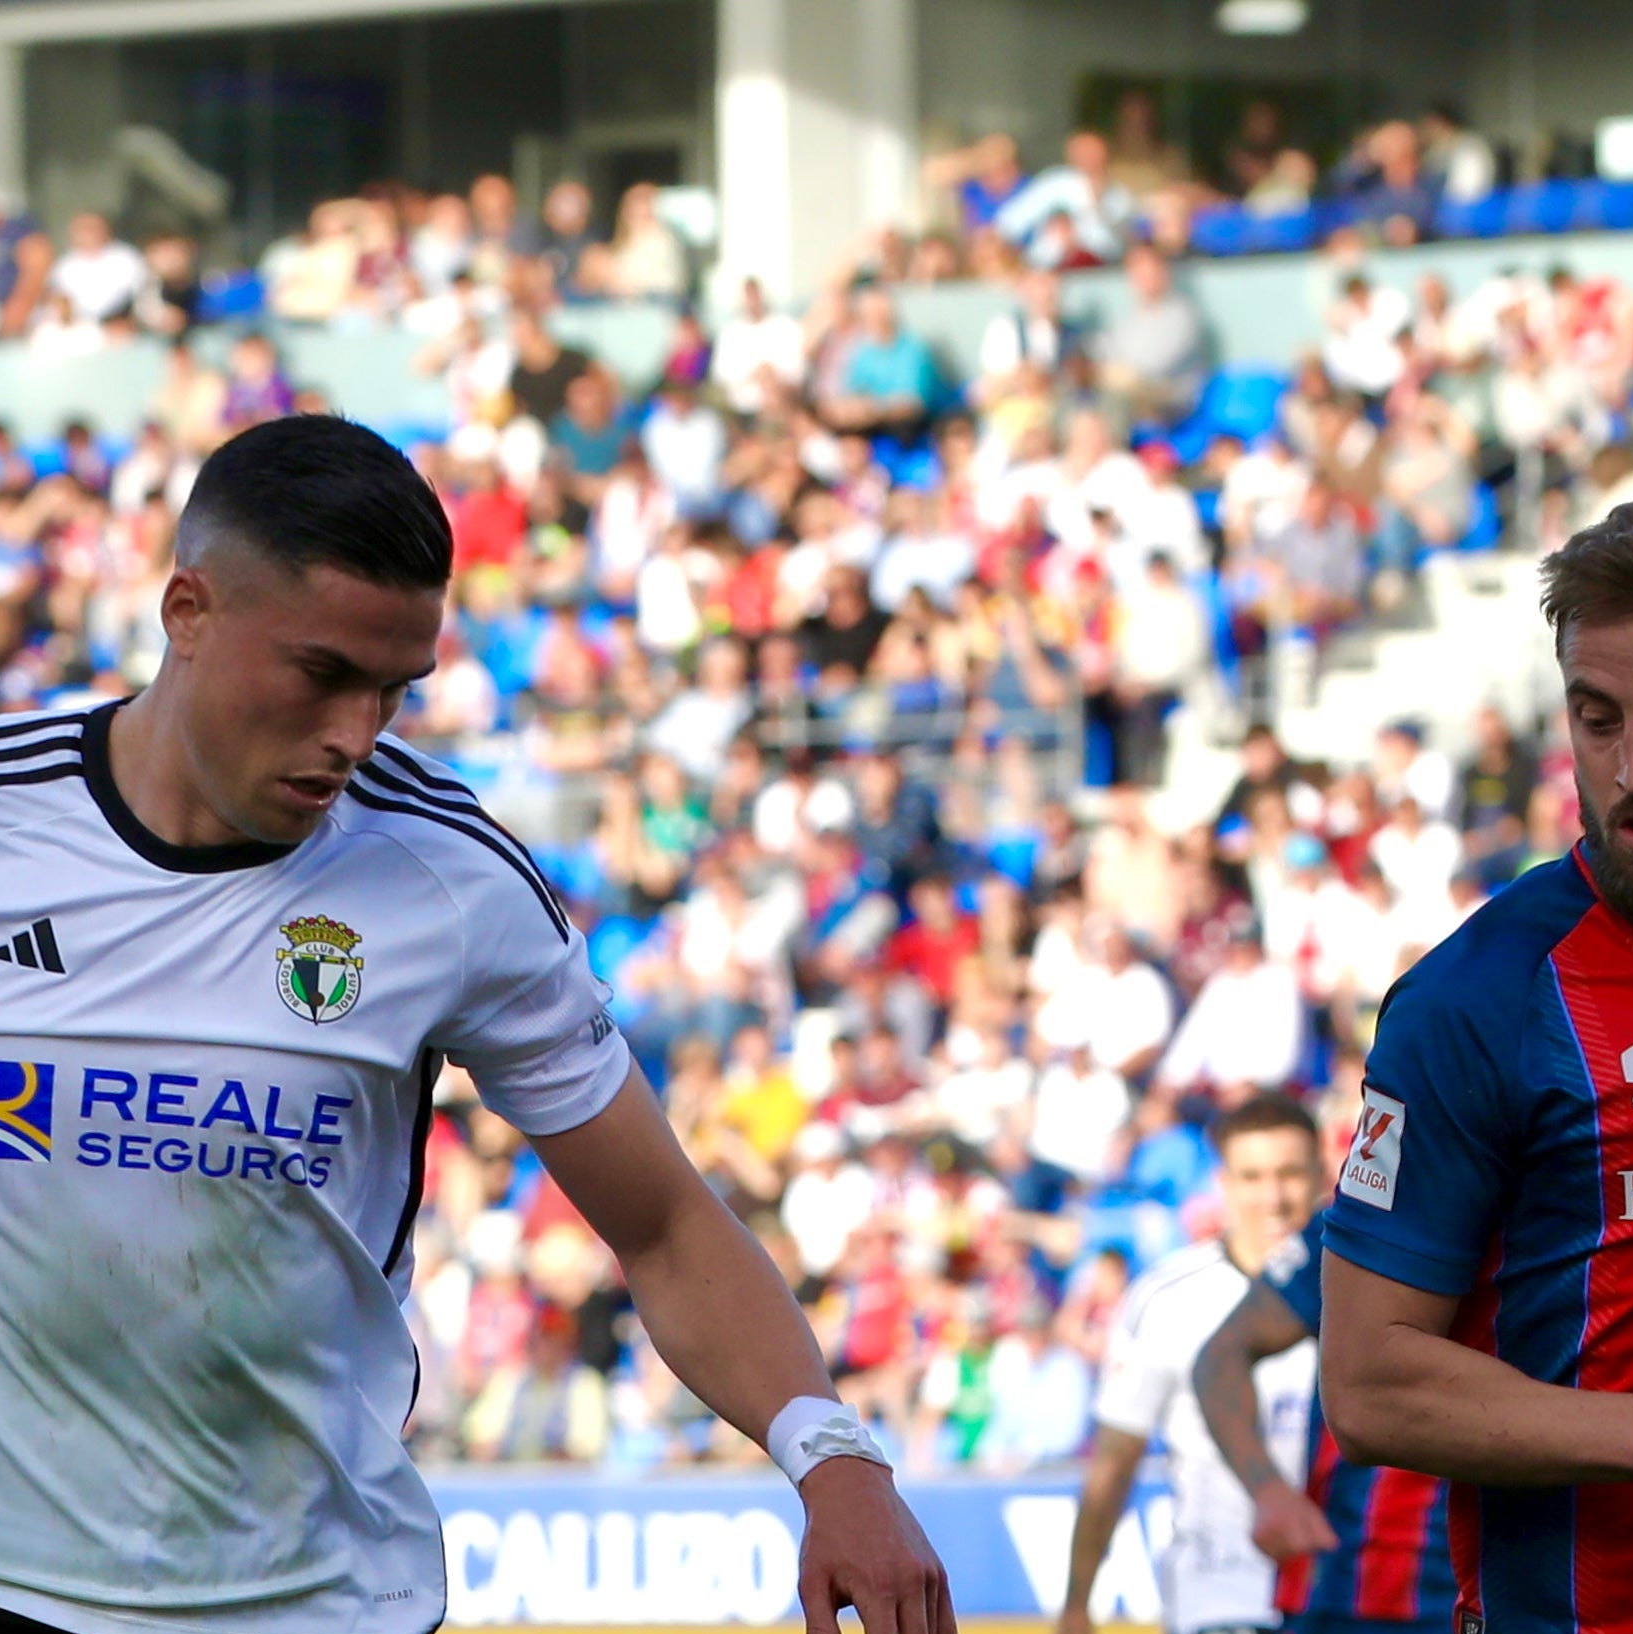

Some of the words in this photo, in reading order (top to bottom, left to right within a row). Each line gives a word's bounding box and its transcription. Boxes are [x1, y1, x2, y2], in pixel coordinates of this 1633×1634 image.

[306, 943, 335, 955] CLUB
[280, 963, 301, 1008] BURGOS
[335, 972, 357, 1012] FUTBOL
[79, 1067, 354, 1145] REALE
[76, 1132, 333, 1188] SEGUROS
[1346, 1162, 1389, 1192] LALIGA
